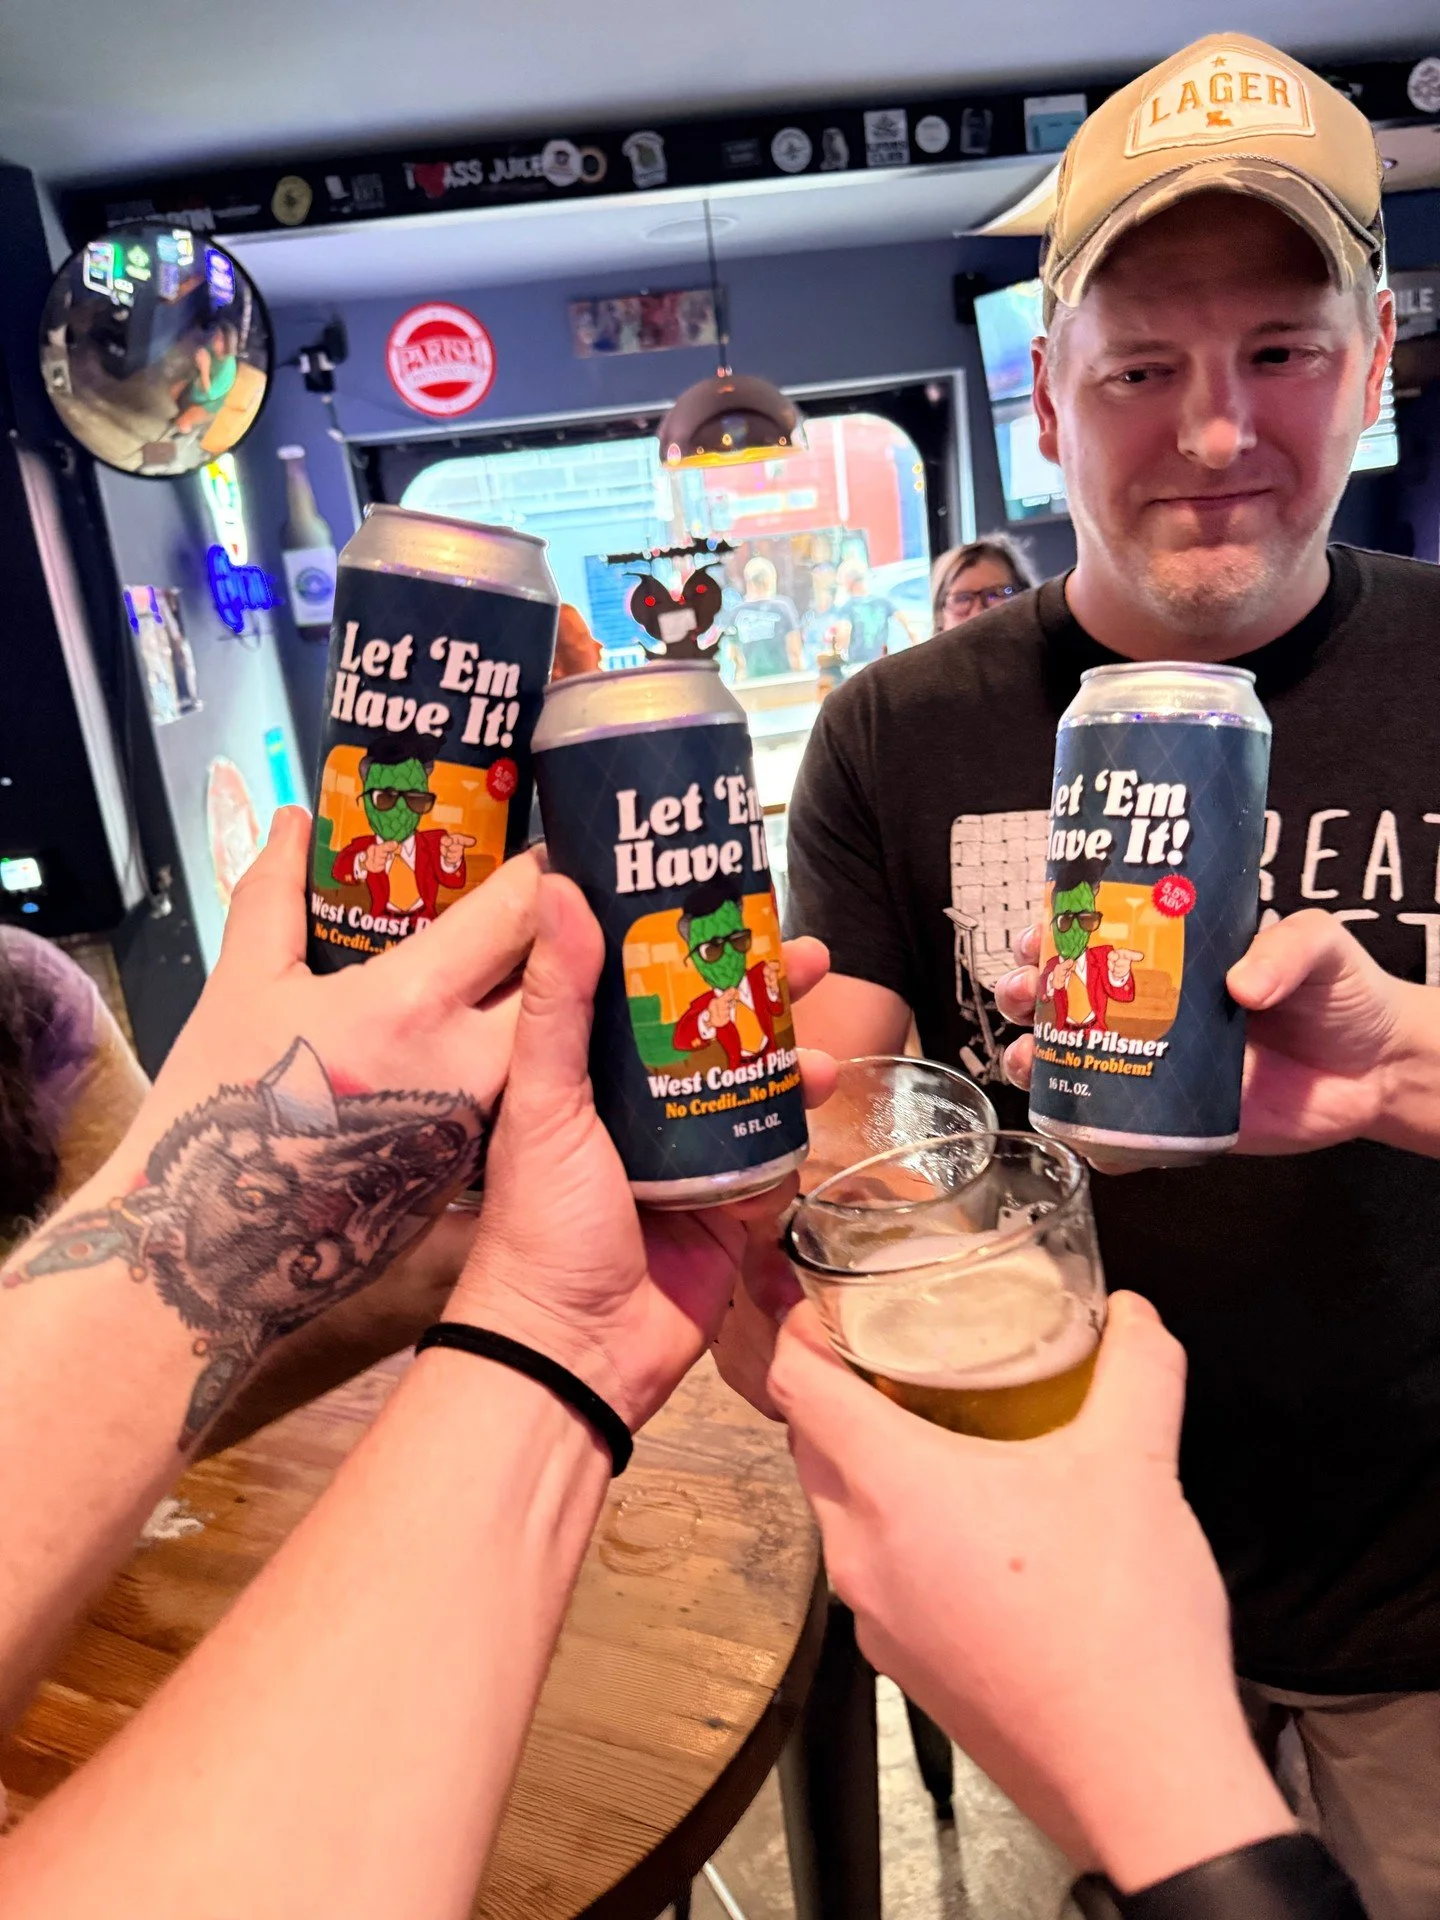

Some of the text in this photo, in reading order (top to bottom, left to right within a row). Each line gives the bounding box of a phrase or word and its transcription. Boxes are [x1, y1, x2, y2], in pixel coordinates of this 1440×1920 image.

[1150, 72, 1291, 125] LAGER
[340, 620, 414, 680] Let
[330, 671, 520, 748] Have It!
[615, 782, 703, 841] Let
[1123, 818, 1190, 866] It!
[614, 840, 742, 894] Have
[311, 892, 345, 924] West
[348, 906, 410, 936] Coast
[1159, 894, 1185, 911] ABV
[314, 923, 328, 940] No
[1043, 1022, 1084, 1048] Coast
[1086, 1028, 1169, 1058] Pilsner
[647, 1070, 702, 1098] West
[706, 1056, 765, 1090] Coast
[1048, 1077, 1058, 1090] 16
[1083, 1053, 1154, 1077] Problem!
[665, 1101, 687, 1119] No
[732, 1122, 747, 1138] 16
